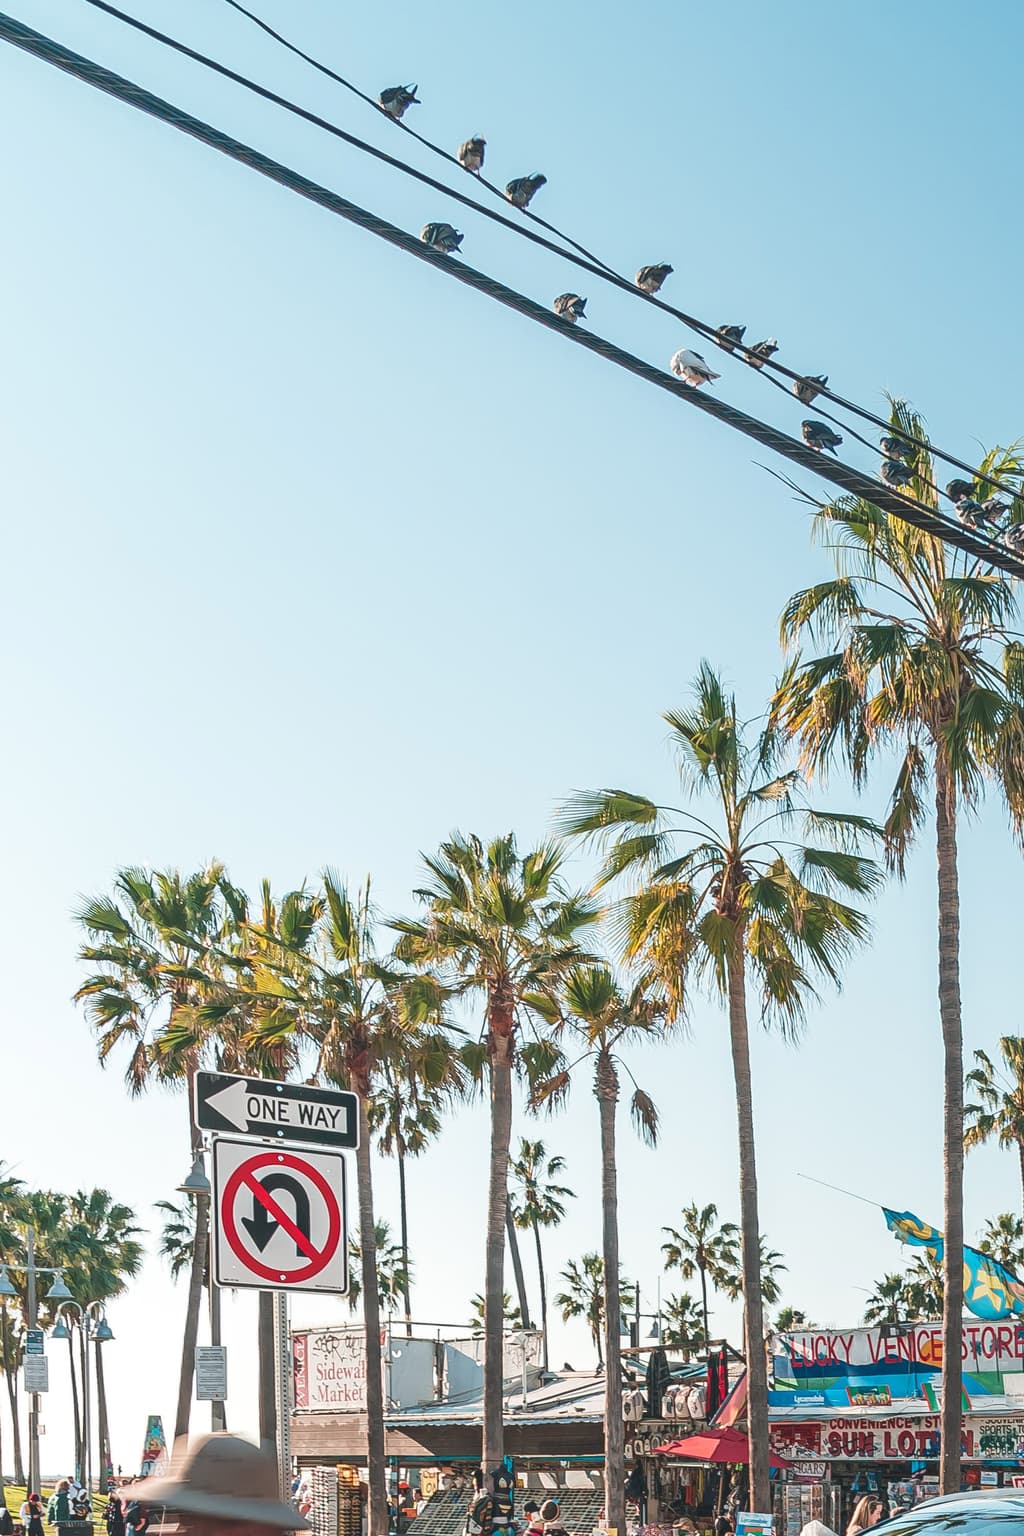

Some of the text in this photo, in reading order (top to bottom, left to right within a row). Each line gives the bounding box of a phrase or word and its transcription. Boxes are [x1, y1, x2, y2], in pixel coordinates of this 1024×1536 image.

[247, 1096, 341, 1129] ONE WAY
[790, 1335, 854, 1368] LUCKY
[867, 1330, 943, 1364] VENICE
[316, 1360, 366, 1381] Sidewal
[318, 1384, 364, 1402] Market
[829, 1416, 966, 1430] CONVENIENCE STE
[979, 1424, 1012, 1435] SPORTS
[828, 1430, 875, 1458] SUN
